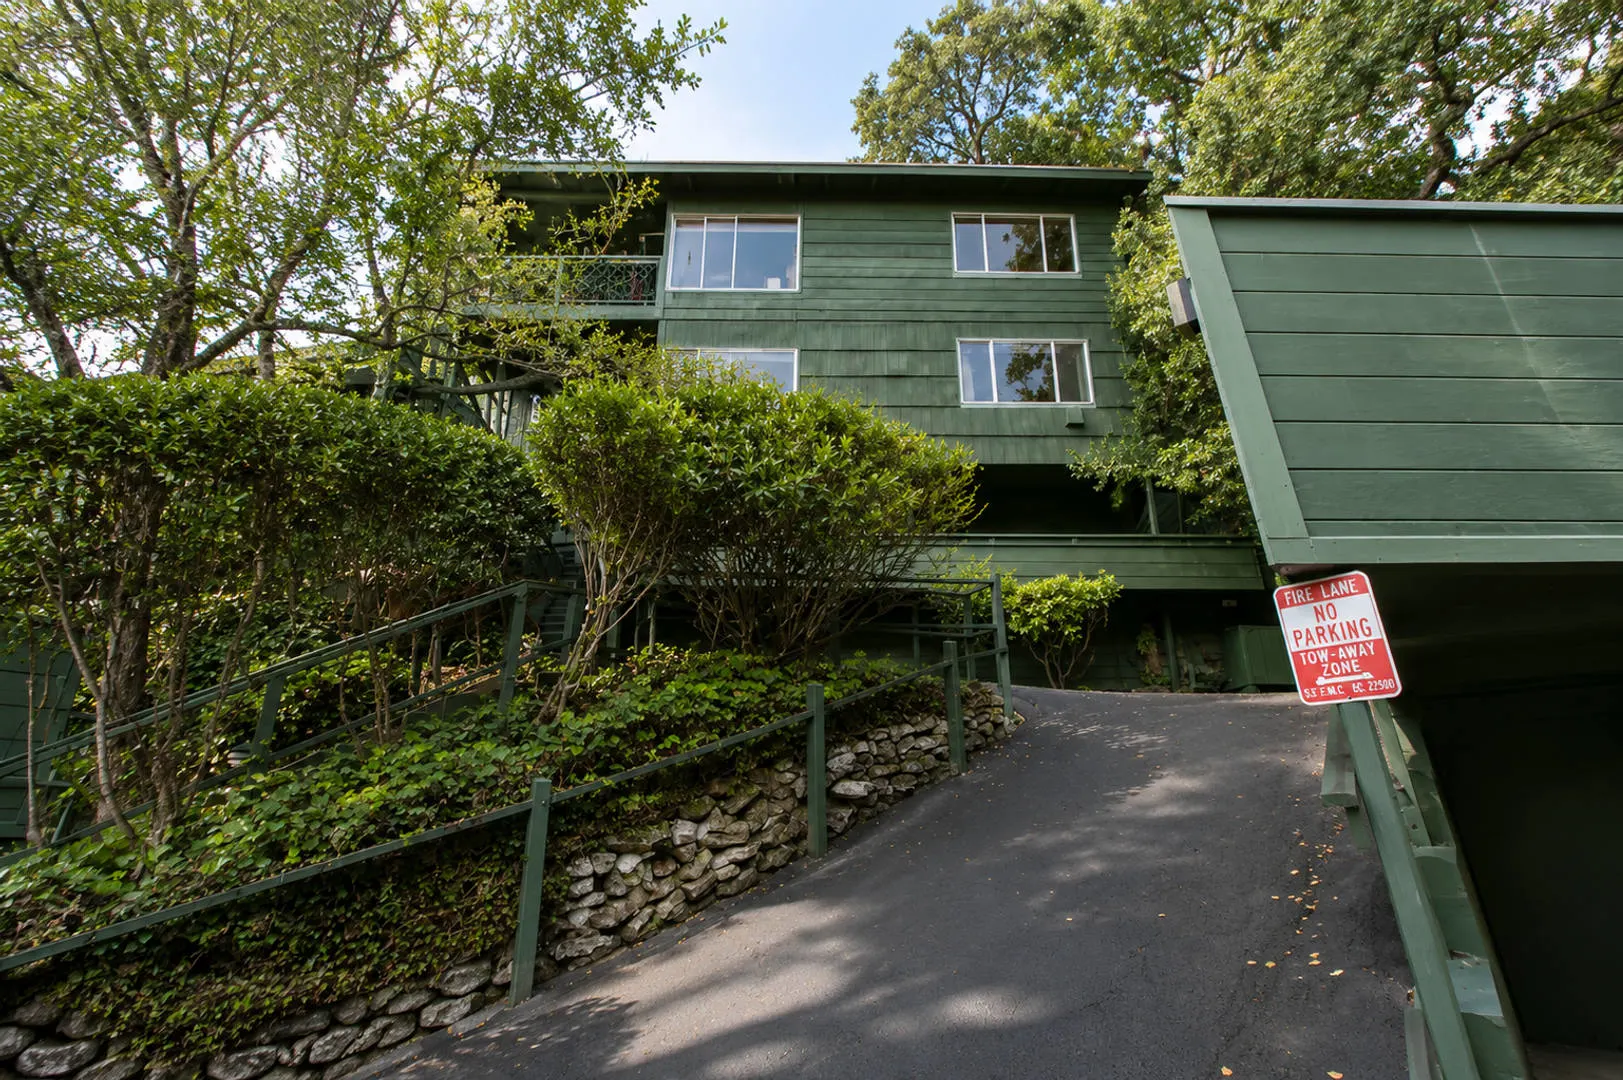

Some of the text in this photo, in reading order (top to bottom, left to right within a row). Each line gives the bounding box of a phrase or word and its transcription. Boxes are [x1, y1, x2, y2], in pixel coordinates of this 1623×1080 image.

[1284, 578, 1358, 605] FIRE LANE
[1313, 602, 1337, 623] NO
[1293, 617, 1372, 648] PARKING
[1300, 641, 1375, 666] TOW-AWAY
[1321, 659, 1361, 677] ZONE
